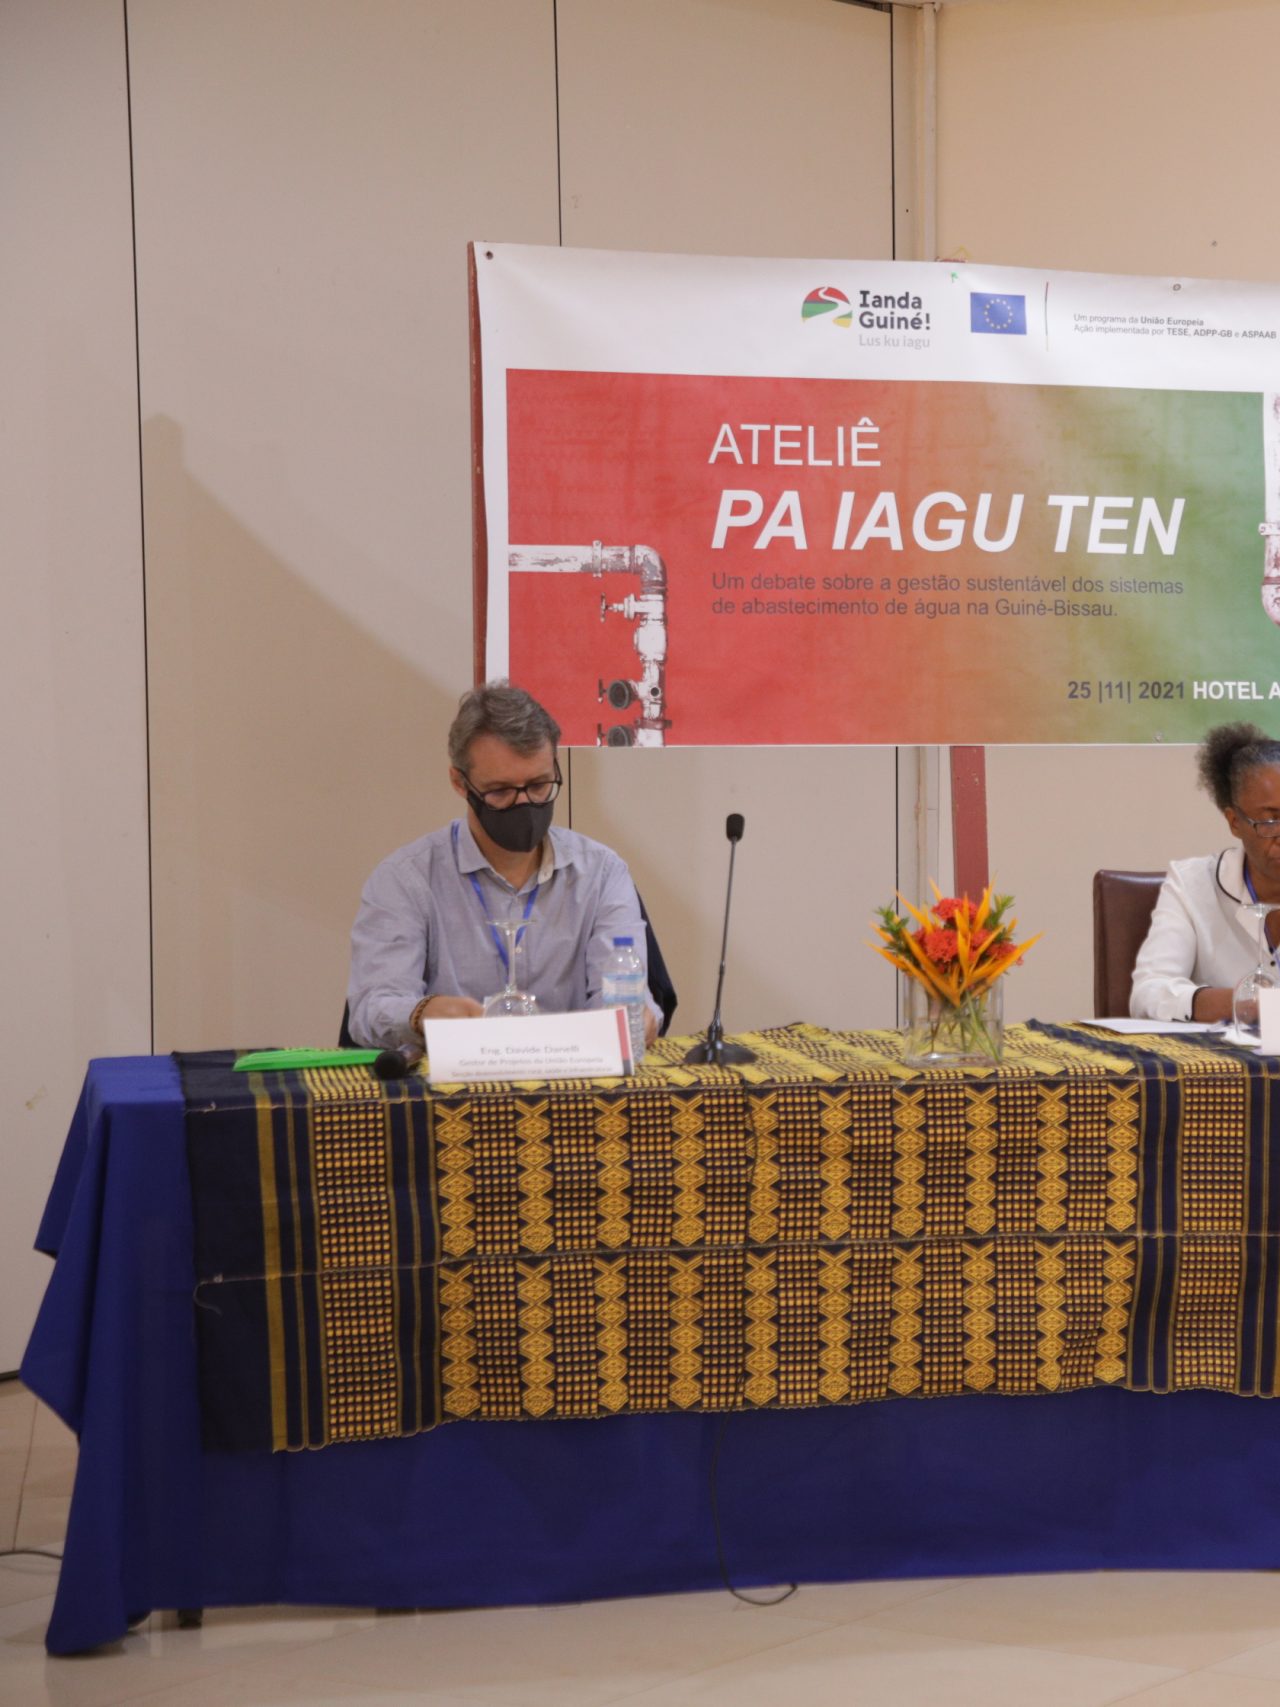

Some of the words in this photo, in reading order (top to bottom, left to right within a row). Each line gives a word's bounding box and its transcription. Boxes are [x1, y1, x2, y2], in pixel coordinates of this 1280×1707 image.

[859, 290, 922, 309] Ianda
[858, 311, 930, 330] Guiné!
[1073, 313, 1088, 322] Um
[1089, 314, 1127, 325] programa
[1128, 315, 1139, 324] da
[1140, 316, 1165, 325] União
[1167, 317, 1204, 327] Europeia
[1074, 323, 1094, 334] Ação
[1095, 325, 1150, 335] implementada
[1151, 327, 1165, 336] por
[1193, 328, 1233, 338] ADPP-GB
[859, 334, 881, 347] Lus
[884, 334, 900, 347] ku
[902, 335, 930, 350] iagu
[707, 416, 881, 467] ATELIÊ
[711, 489, 808, 550] PA
[832, 491, 1025, 553] IAGU
[1047, 494, 1186, 555] TEN
[712, 572, 745, 590] Um
[751, 573, 816, 590] debate
[822, 574, 873, 591] sobre
[880, 578, 891, 591] a
[897, 574, 960, 595] gestão
[966, 576, 1066, 593] sustentável
[1072, 576, 1104, 593] dos
[1110, 577, 1184, 594] sistemas
[712, 598, 735, 615] de
[742, 598, 879, 615] abastecimento
[885, 598, 907, 615] de
[914, 598, 960, 620] água
[967, 602, 988, 615] na
[995, 599, 1118, 616] Guiné-Bissau.
[1067, 681, 1092, 700] 25
[1138, 681, 1185, 700] 2021
[1193, 681, 1264, 700] HOTEL
